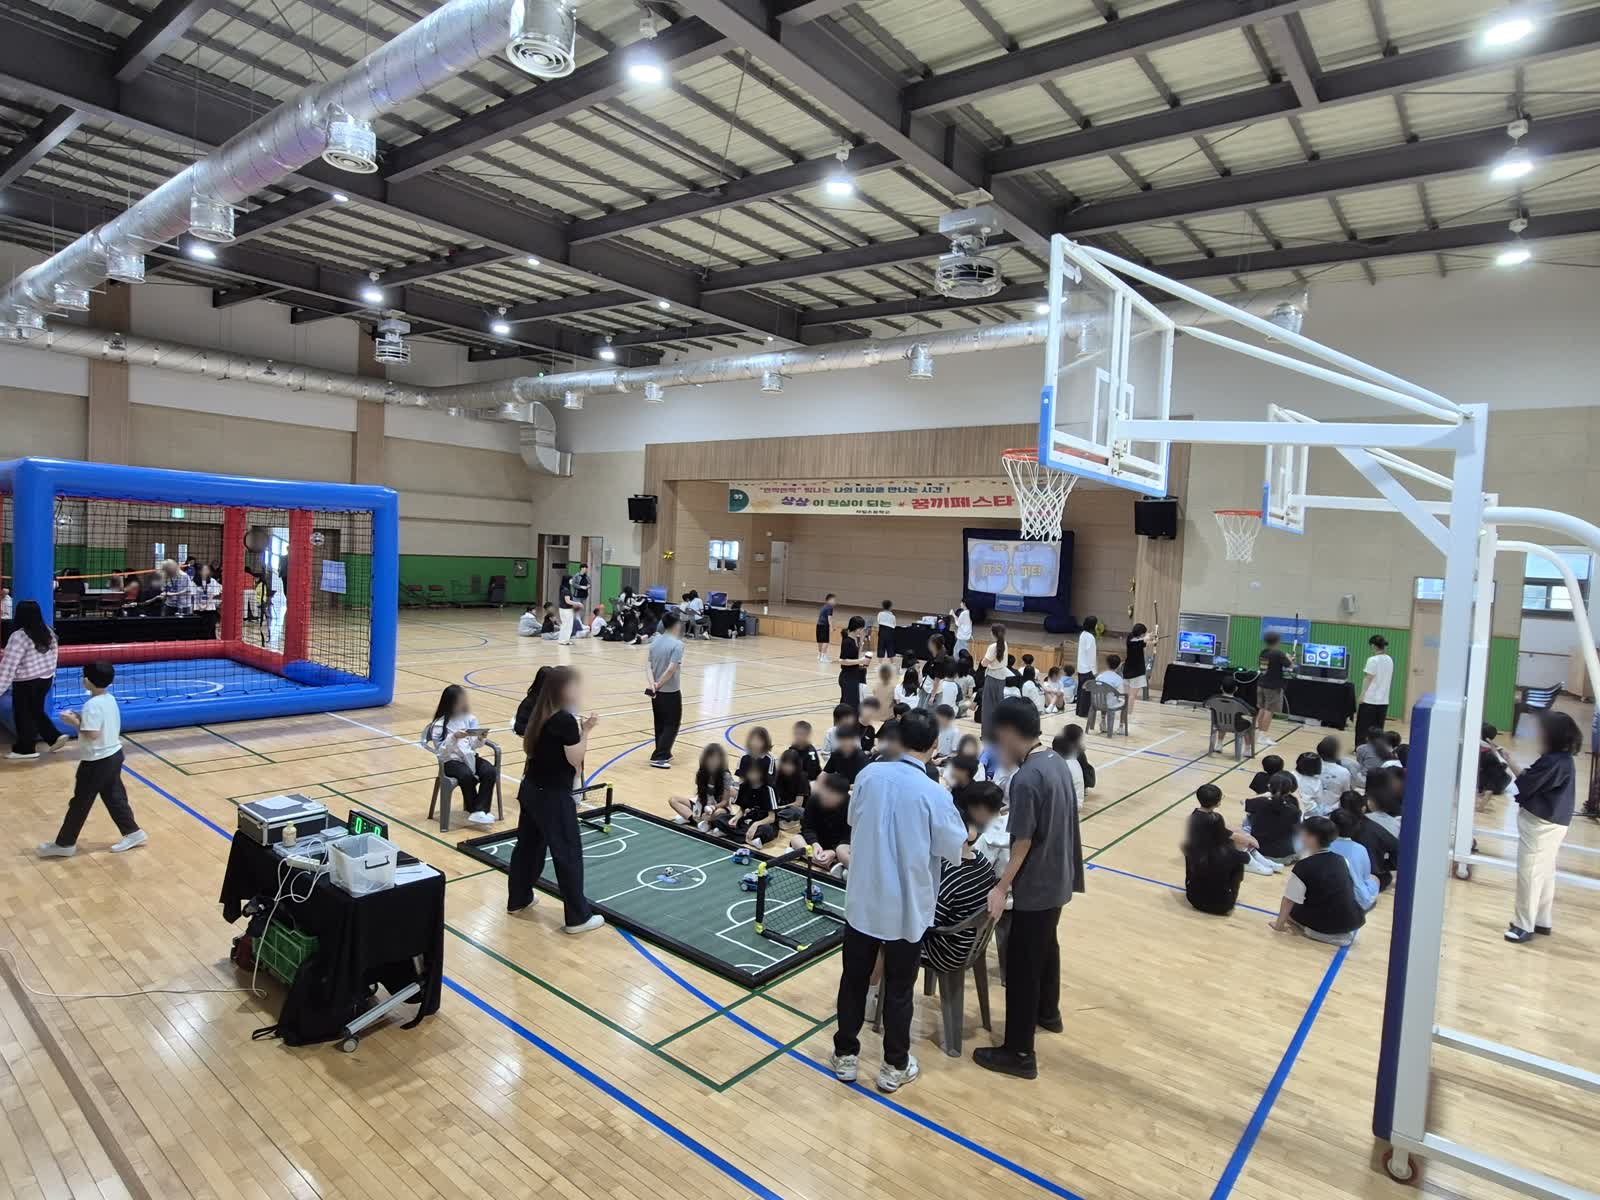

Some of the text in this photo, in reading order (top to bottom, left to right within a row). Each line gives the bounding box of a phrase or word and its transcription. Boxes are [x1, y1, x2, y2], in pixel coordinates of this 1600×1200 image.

[781, 496, 809, 507] 상상
[828, 499, 863, 507] 현실이
[867, 499, 892, 508] 되는
[912, 495, 1015, 510] 꿈끼페스타
